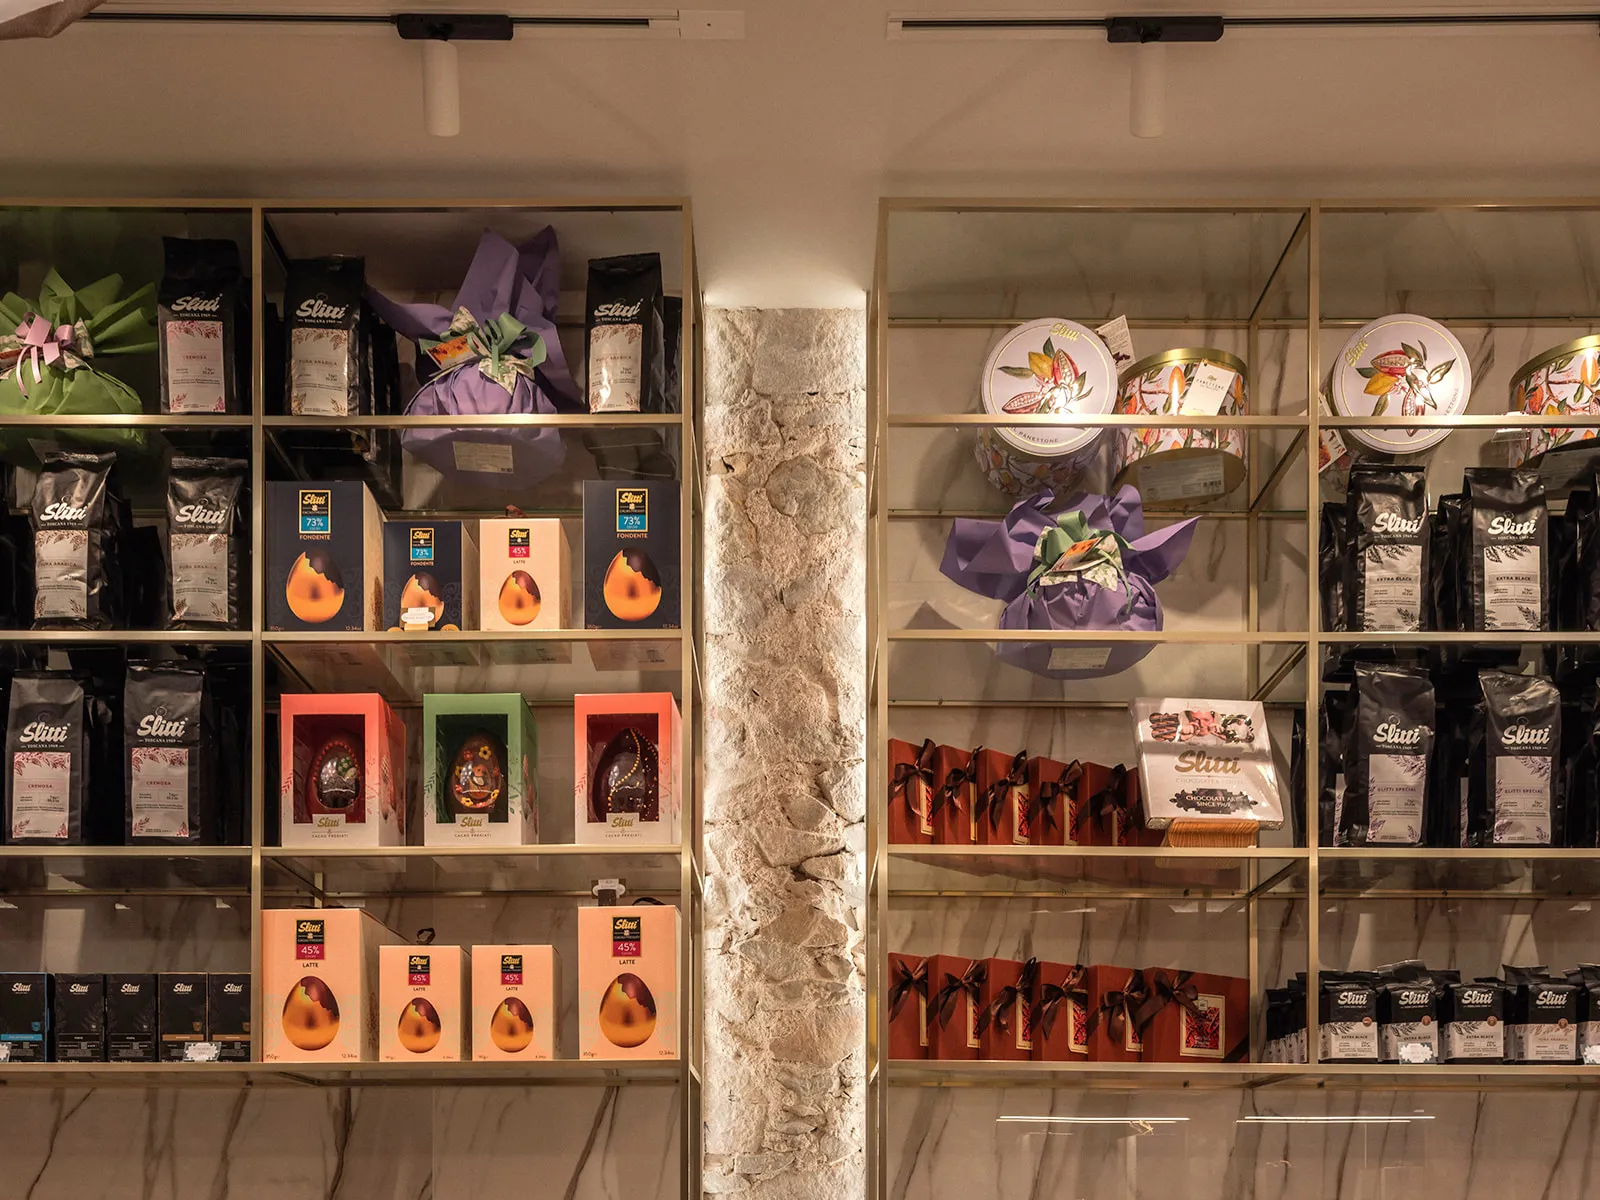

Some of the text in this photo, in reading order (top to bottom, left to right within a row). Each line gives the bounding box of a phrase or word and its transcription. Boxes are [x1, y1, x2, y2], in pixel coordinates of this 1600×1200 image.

[171, 295, 221, 312] Slitti
[296, 299, 346, 319] Slitti
[1018, 431, 1058, 443] PANETTONE
[303, 494, 326, 505] Slitti
[620, 492, 643, 503] Slitti
[40, 502, 88, 521] Slitti
[175, 505, 226, 524] Slitti
[306, 517, 324, 527] 73%
[623, 516, 641, 526] 73%
[1371, 512, 1420, 533] Slitti
[1487, 516, 1537, 535] Slitti
[20, 721, 68, 743] Slitti
[137, 714, 186, 738] Slitti
[1373, 722, 1421, 745] Slitti
[1501, 725, 1550, 745] Slitti
[1174, 749, 1241, 774] Slitti
[317, 817, 340, 828] Slitti
[460, 816, 483, 827] Slitti
[611, 817, 634, 828] Slitti
[298, 921, 321, 933] Slitti
[614, 918, 638, 930] Slitti
[301, 945, 320, 955] 45%
[617, 942, 636, 952] 45%
[1337, 991, 1368, 1005] Slitti
[1398, 991, 1430, 1005] Slitti
[1461, 990, 1494, 1005] Slitti
[1535, 990, 1569, 1005] Slitti
